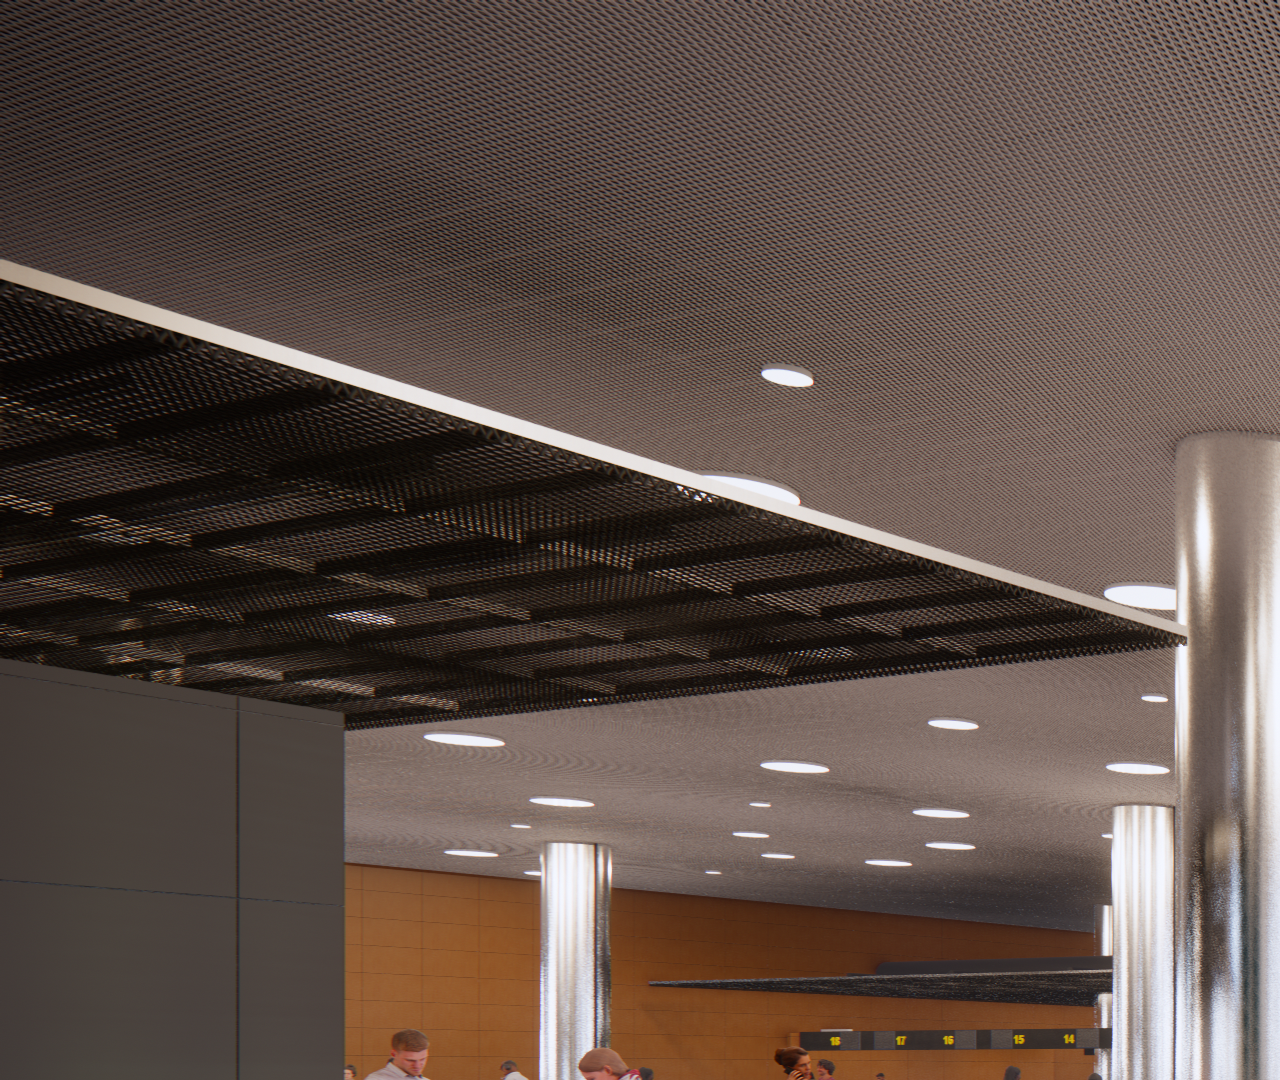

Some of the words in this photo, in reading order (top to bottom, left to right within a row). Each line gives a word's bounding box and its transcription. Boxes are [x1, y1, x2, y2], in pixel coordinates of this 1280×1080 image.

[895, 1035, 907, 1046] 17
[942, 1035, 954, 1045] 16
[1013, 1034, 1025, 1045] 15
[1063, 1033, 1075, 1044] 14
